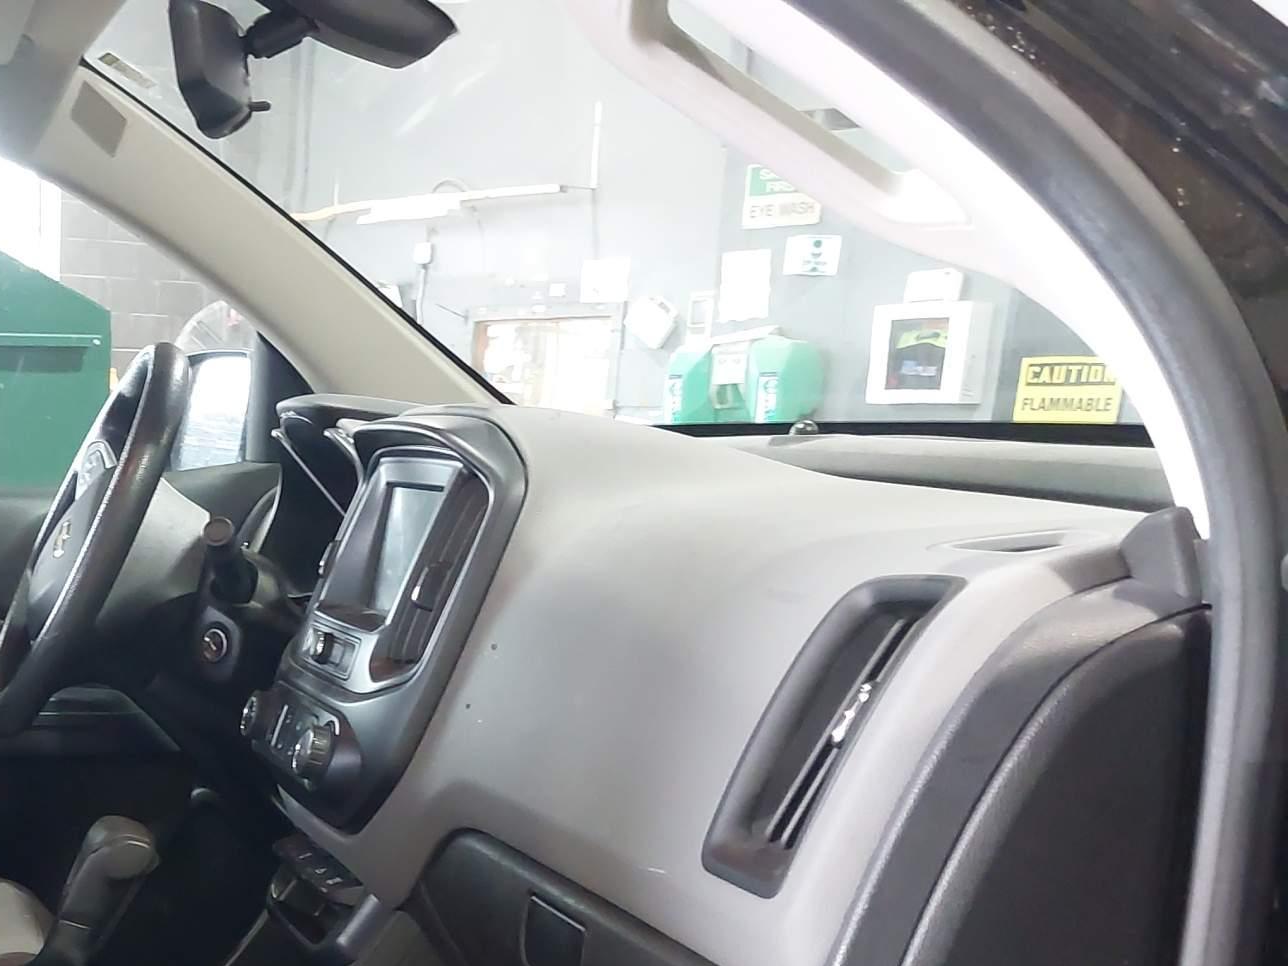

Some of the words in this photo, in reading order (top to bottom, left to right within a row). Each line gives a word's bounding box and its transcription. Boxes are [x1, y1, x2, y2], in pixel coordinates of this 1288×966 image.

[749, 203, 775, 219] EYE
[778, 201, 816, 216] WASH
[1021, 397, 1113, 412] FLAMMABLE
